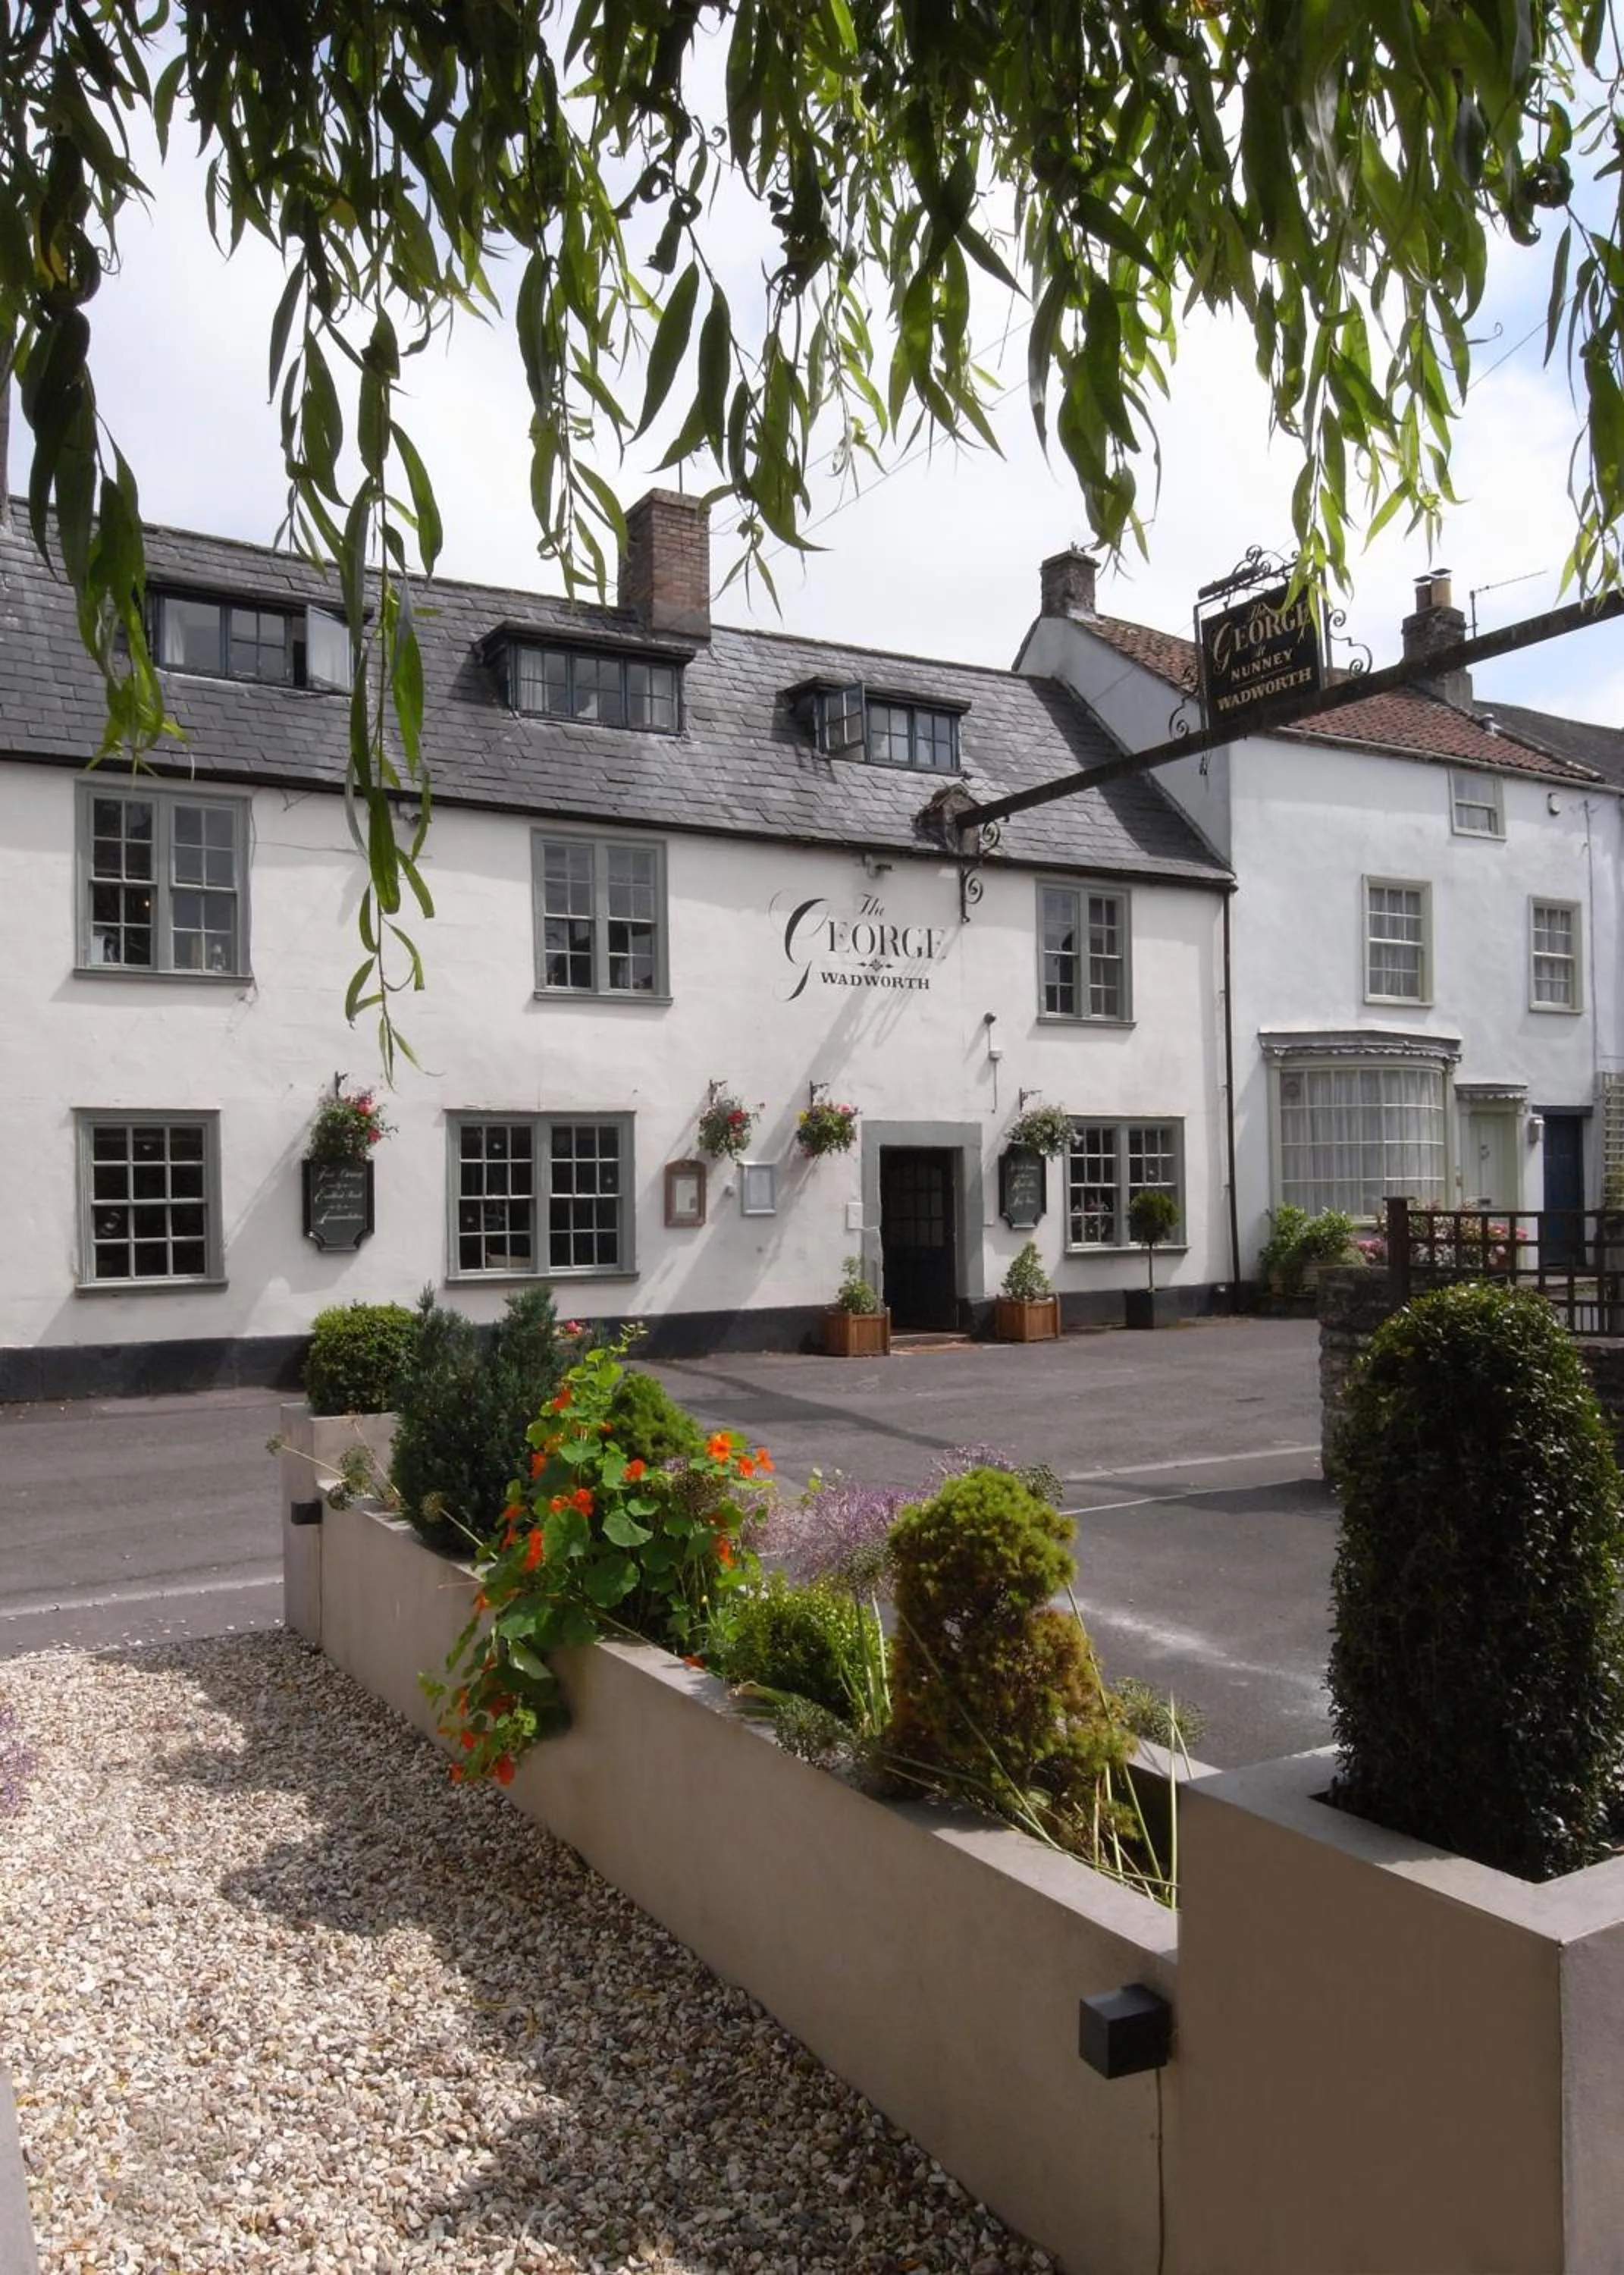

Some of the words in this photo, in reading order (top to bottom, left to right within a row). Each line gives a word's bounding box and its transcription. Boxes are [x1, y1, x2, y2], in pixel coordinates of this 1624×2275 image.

[1231, 648, 1293, 681] NUNNEY
[1216, 667, 1312, 711] WADWORTH
[859, 892, 886, 916] The
[769, 890, 948, 1002] GEORGE
[820, 971, 930, 990] WADWORTH
